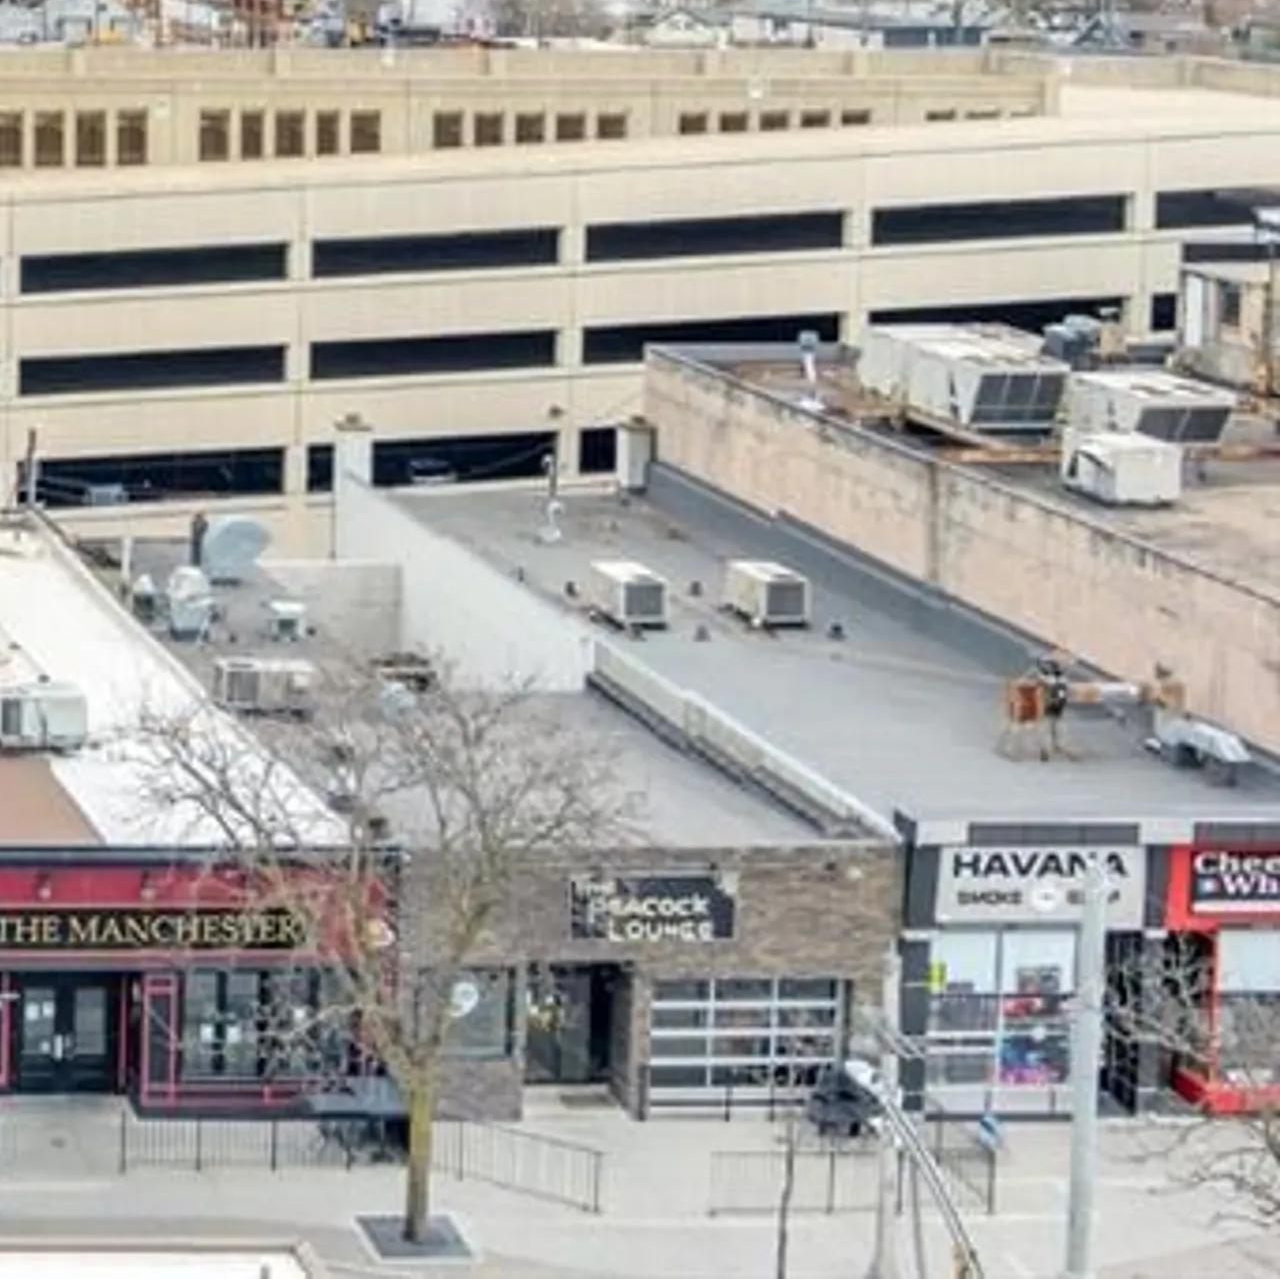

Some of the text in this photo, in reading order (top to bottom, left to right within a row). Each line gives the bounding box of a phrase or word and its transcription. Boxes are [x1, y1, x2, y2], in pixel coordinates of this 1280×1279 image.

[953, 852, 1128, 878] HAVANA
[69, 915, 306, 943] MANCHESTER
[608, 920, 714, 942] LOUNGE
